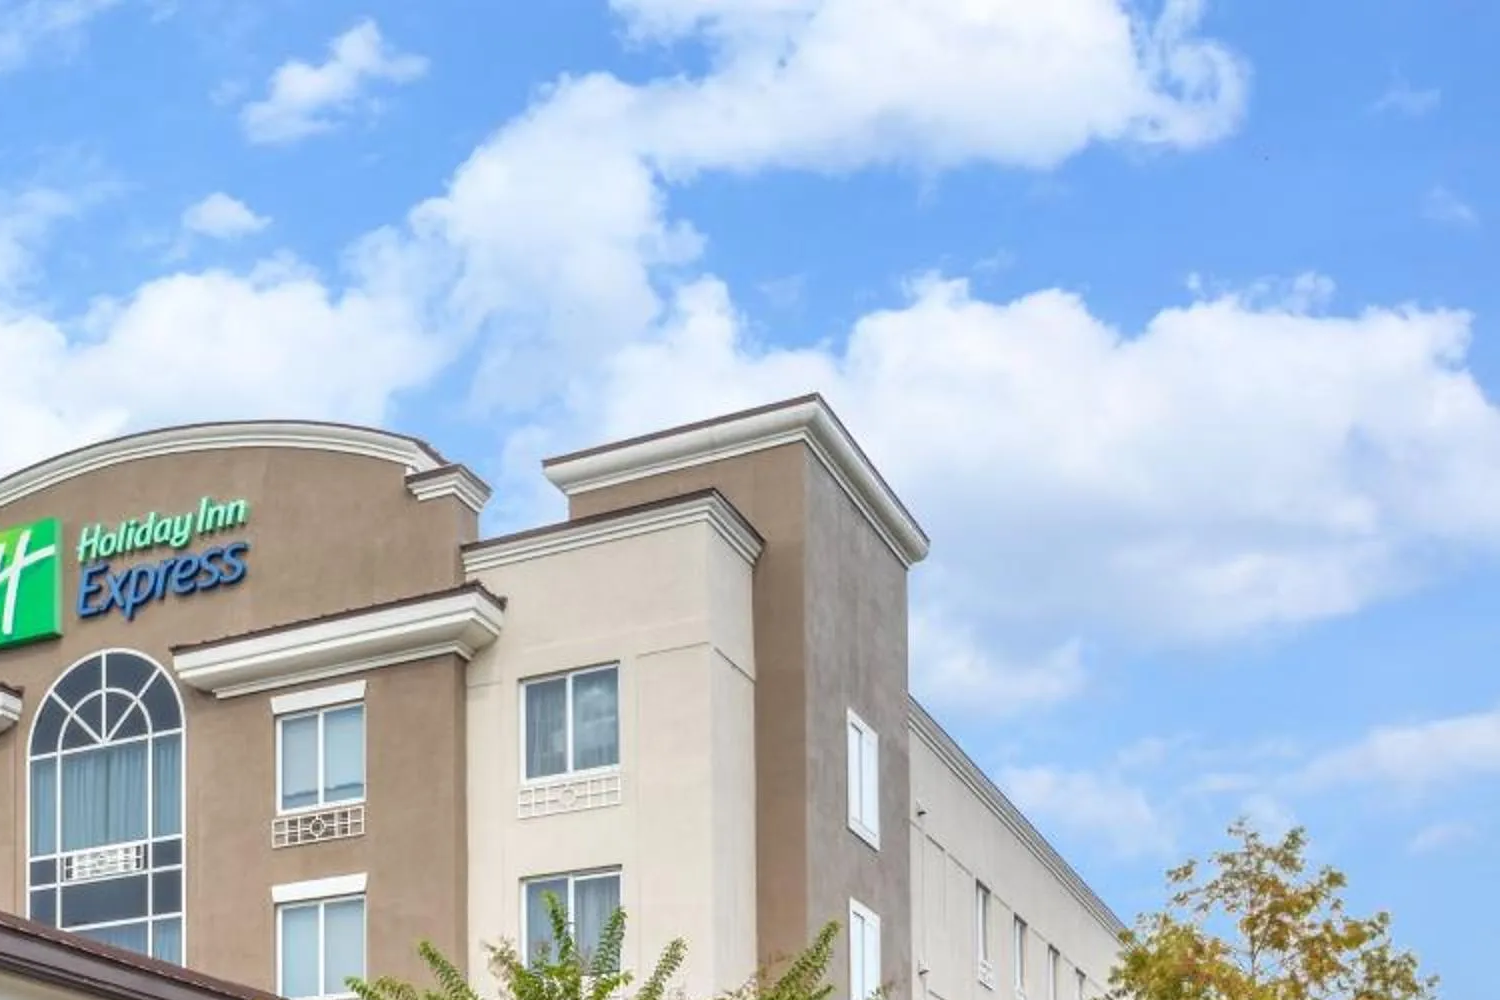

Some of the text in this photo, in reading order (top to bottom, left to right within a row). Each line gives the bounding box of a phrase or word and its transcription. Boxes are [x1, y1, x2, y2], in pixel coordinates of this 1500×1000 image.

[76, 495, 247, 562] Holiday Inn
[76, 542, 250, 619] Express
